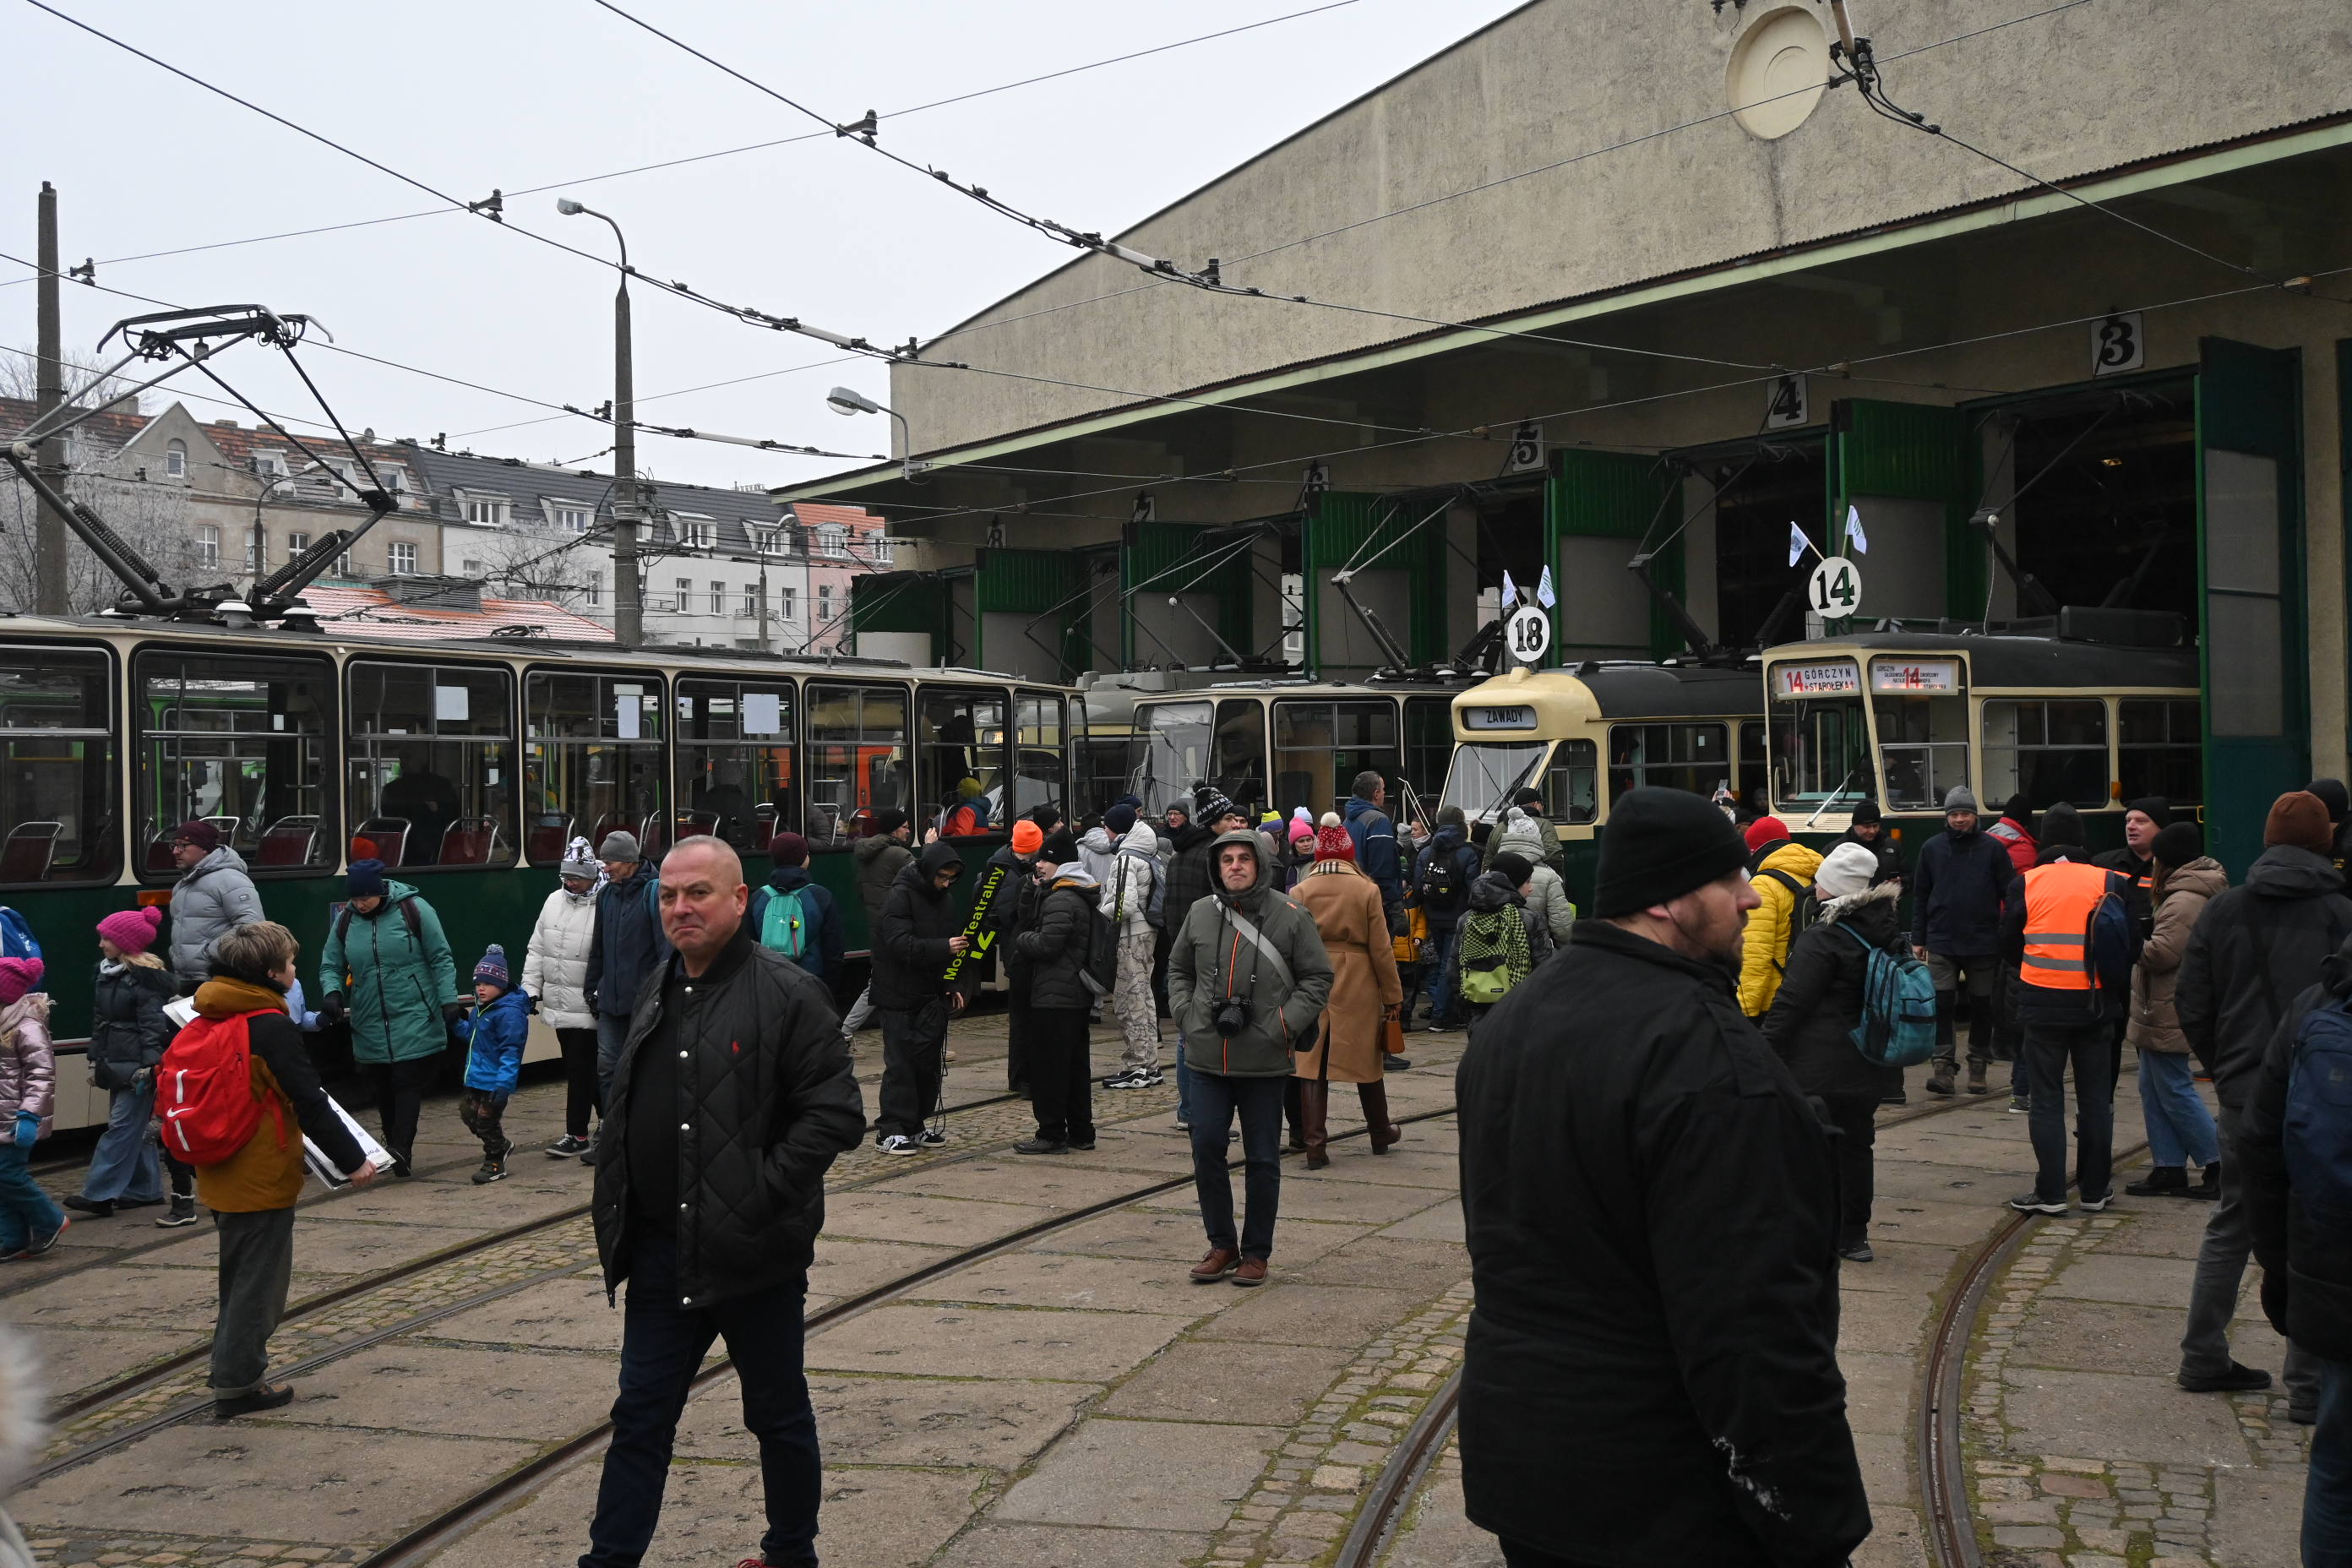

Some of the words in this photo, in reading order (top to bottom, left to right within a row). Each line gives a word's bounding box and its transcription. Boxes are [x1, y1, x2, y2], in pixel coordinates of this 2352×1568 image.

[2099, 322, 2135, 366] 3
[1773, 381, 1802, 420] 4
[1516, 429, 1538, 464] 5
[1816, 566, 1855, 609] 14
[1516, 617, 1543, 652] 18
[1786, 671, 1804, 692] 14
[1805, 667, 1851, 680] GÓRCZYN
[1903, 667, 1920, 689] 14
[1485, 709, 1525, 724] ZAWADY
[943, 945, 968, 980] Mos
[962, 867, 1004, 938] Teatralny
